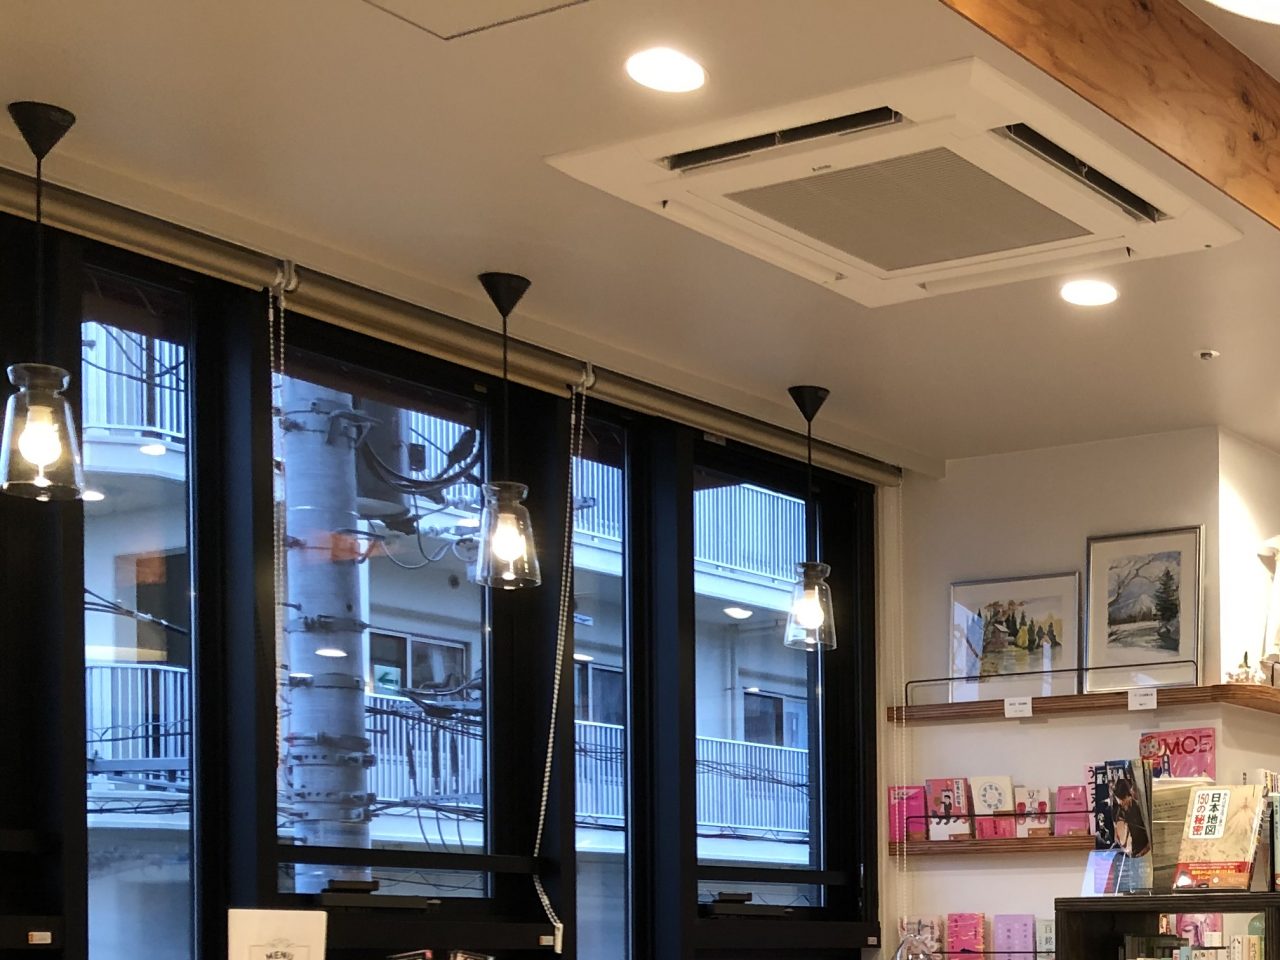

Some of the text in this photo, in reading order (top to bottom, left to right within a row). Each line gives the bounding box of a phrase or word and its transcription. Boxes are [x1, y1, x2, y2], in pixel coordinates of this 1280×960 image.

[1192, 793, 1210, 836] 150の秘密
[1204, 792, 1221, 835] 日本地図
[265, 951, 294, 960] MENU
